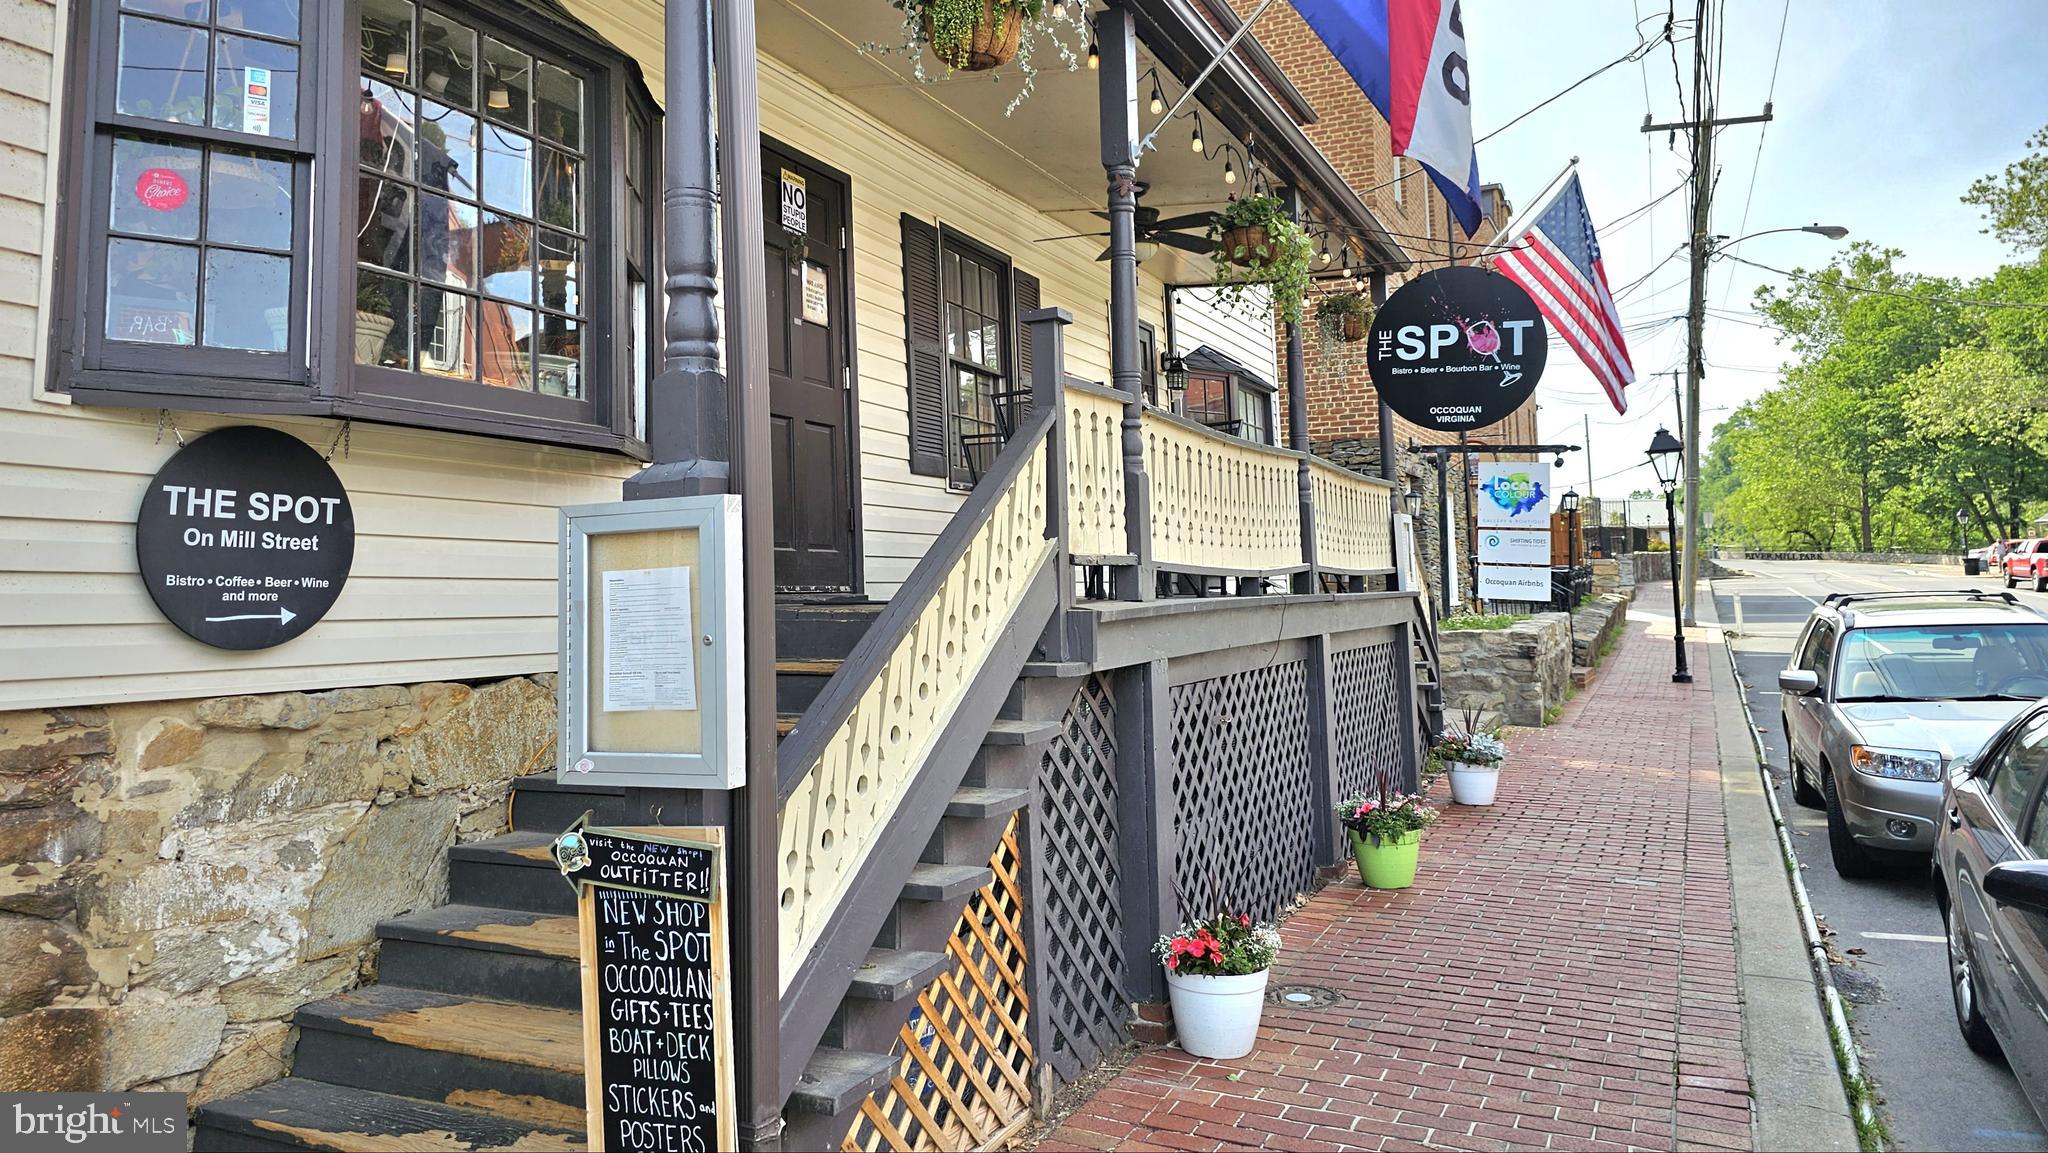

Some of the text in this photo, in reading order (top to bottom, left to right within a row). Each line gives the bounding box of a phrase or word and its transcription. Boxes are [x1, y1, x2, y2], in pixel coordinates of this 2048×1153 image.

[144, 184, 181, 199] Choice
[783, 181, 805, 209] NO
[783, 204, 805, 221] STUPID
[783, 214, 805, 231] PEOPLE
[1379, 329, 1392, 361] THE
[1446, 365, 1477, 373] Bourbon
[1430, 406, 1482, 415] OCCOQUAN
[1436, 415, 1475, 423] VIRGINIA
[1494, 490, 1536, 499] COLOUR
[163, 485, 340, 525] THE SPOT
[184, 528, 318, 551] On Mill Street
[166, 574, 329, 588] Bistro Coffee Beer Wine
[1485, 578, 1543, 587] Occoquan Airbnbs
[222, 590, 278, 601] and more
[590, 837, 613, 849] visit
[621, 841, 635, 851] the
[643, 843, 669, 854] NEW
[611, 851, 689, 867] OCCOQUAN
[604, 899, 705, 927] NEW SHOP
[604, 930, 711, 962] in The SPOT
[605, 964, 712, 1000] OCCOQUAN
[611, 998, 660, 1025] GIFTS
[669, 1002, 713, 1030] TEES
[609, 1028, 656, 1055] BOAT
[666, 1032, 711, 1061] DECK
[633, 1058, 690, 1083] PILLOWS
[609, 1084, 716, 1120] STICKERS and
[620, 1119, 706, 1153] POSTERS
